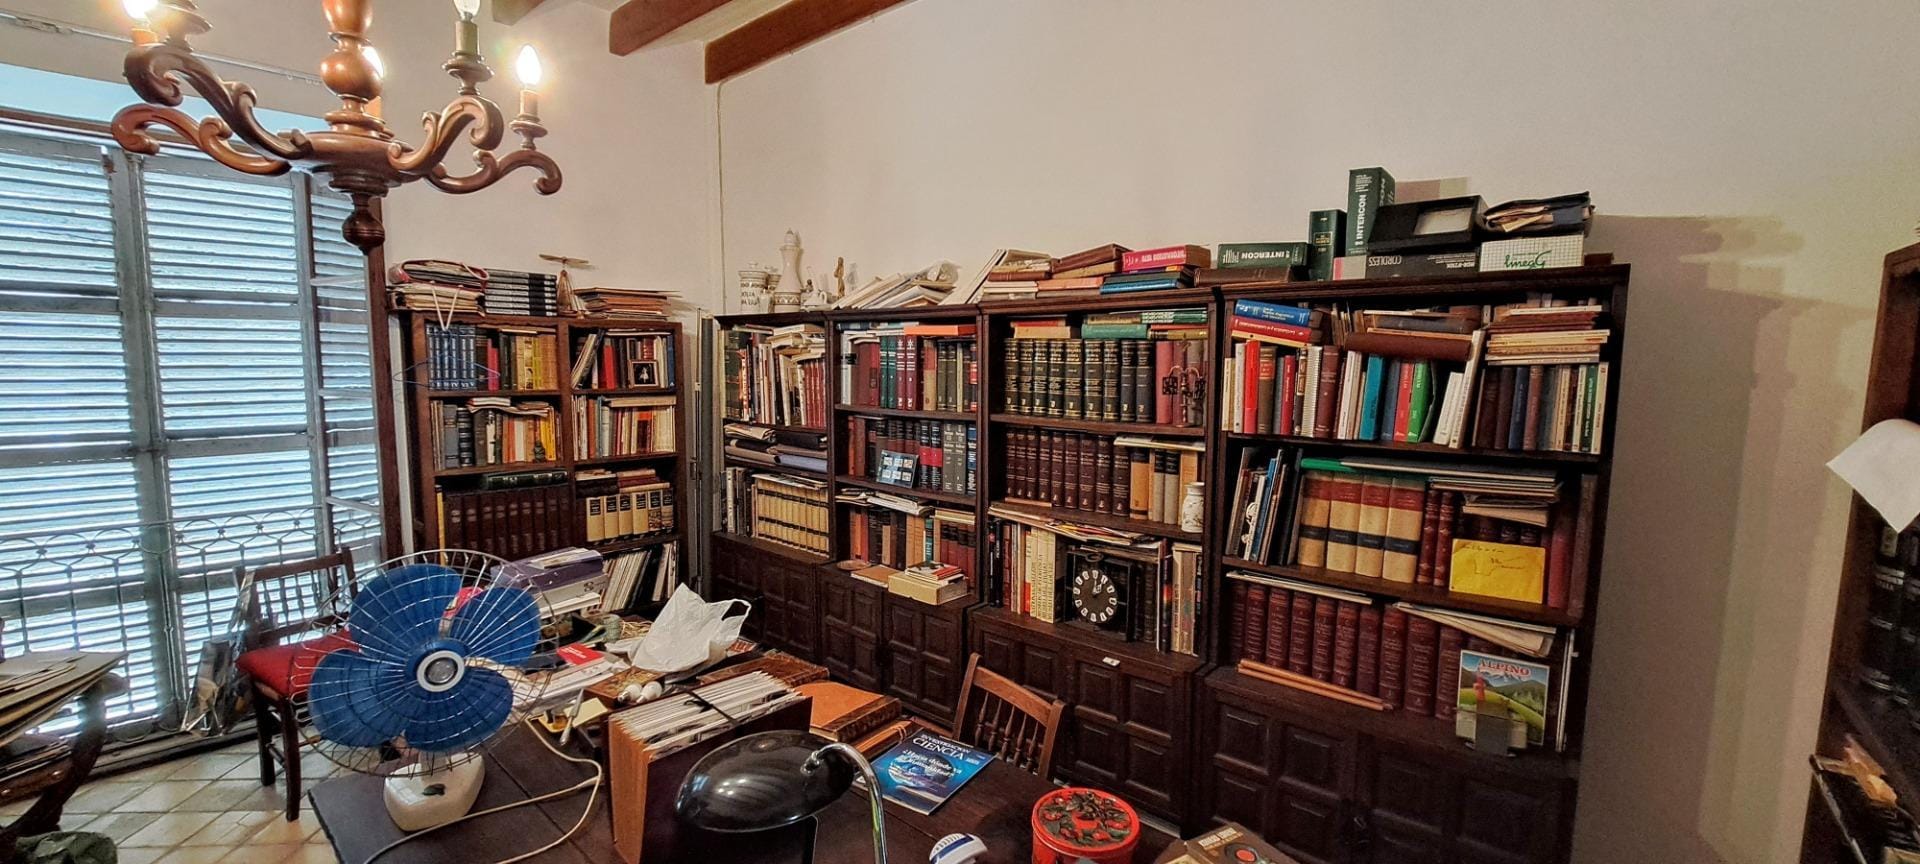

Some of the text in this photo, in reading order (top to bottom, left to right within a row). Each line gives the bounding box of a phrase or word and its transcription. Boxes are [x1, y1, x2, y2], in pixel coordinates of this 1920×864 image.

[1356, 194, 1367, 240] INTERCON
[1241, 250, 1285, 260] INTERCON
[1368, 255, 1402, 266] CORDLESS
[1478, 658, 1531, 678] ALPINO
[912, 737, 964, 760] CIENCIA
